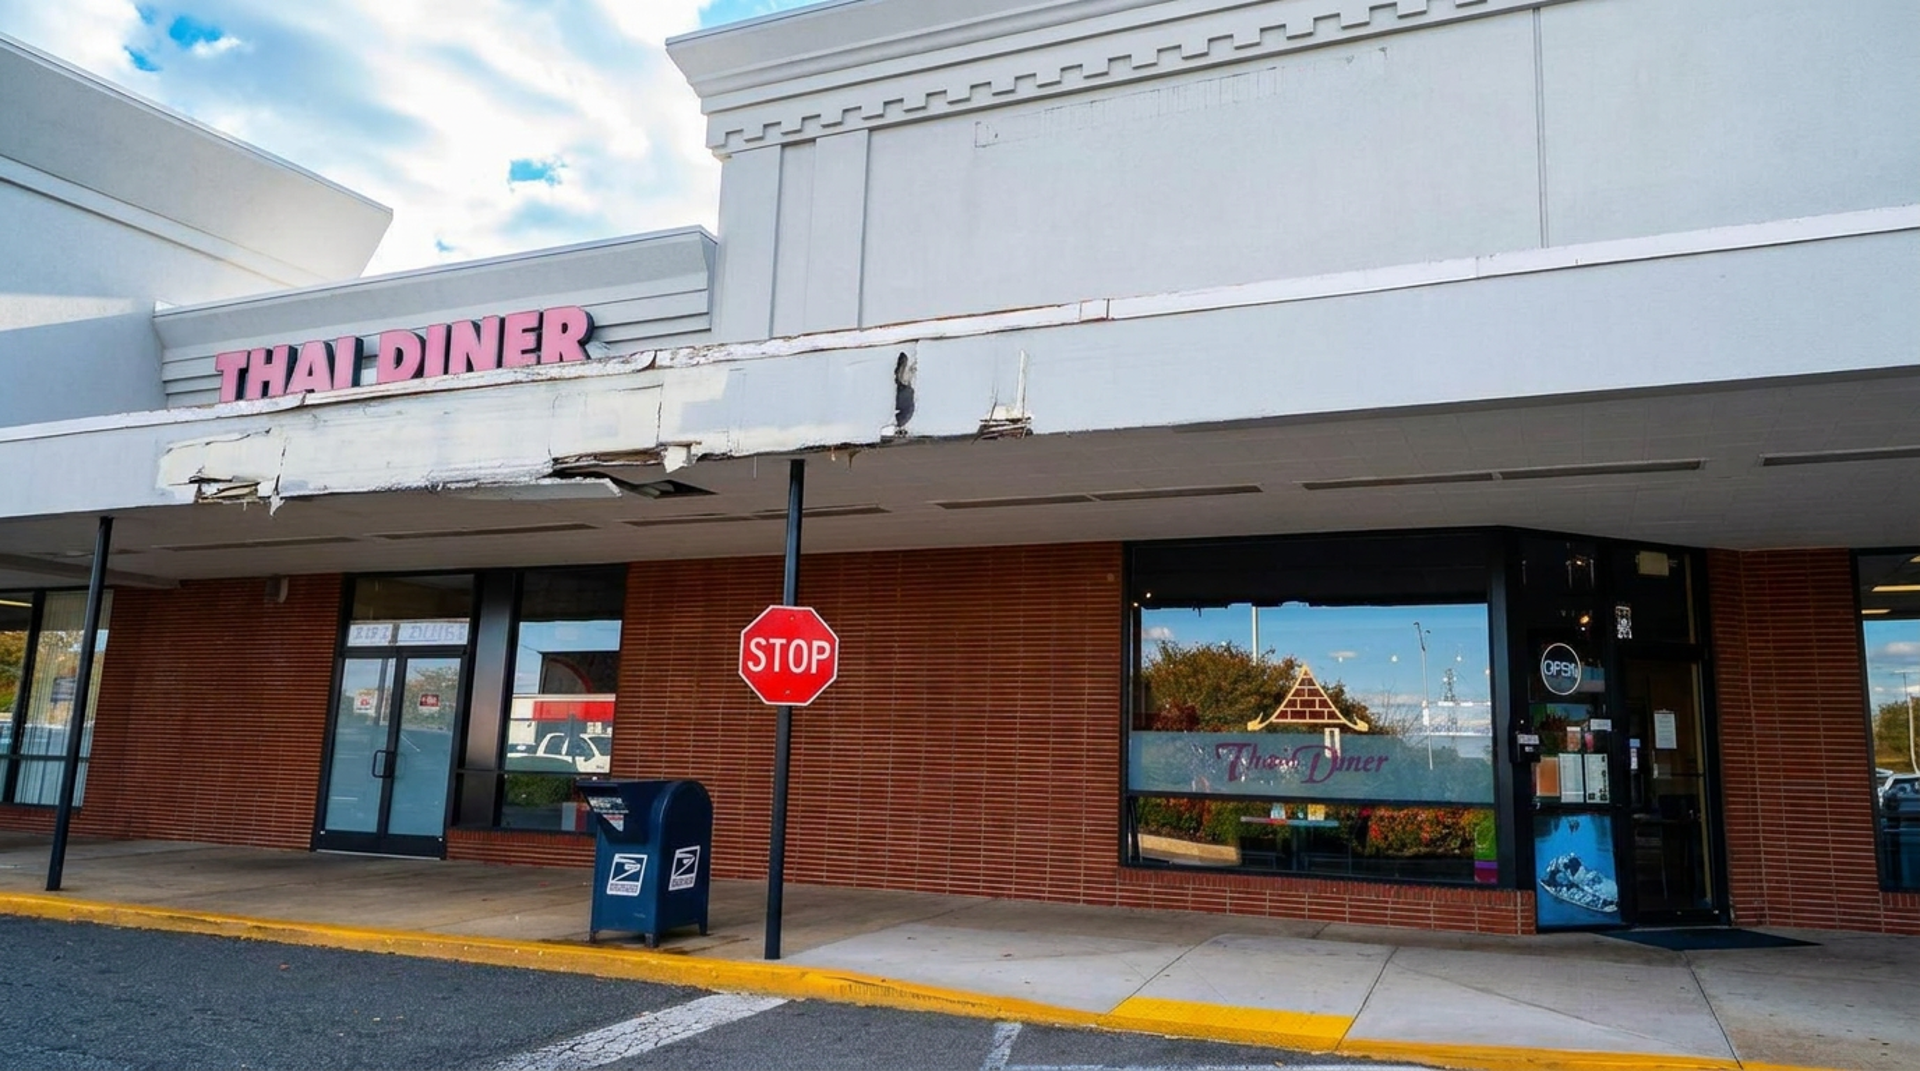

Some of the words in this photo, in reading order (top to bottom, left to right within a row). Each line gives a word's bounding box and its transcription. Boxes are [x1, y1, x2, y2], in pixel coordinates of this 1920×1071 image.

[216, 335, 362, 402] THAI
[377, 305, 594, 384] DINER
[747, 637, 831, 674] STOP
[1216, 743, 1291, 782] Thai
[1291, 744, 1389, 784] Diner
